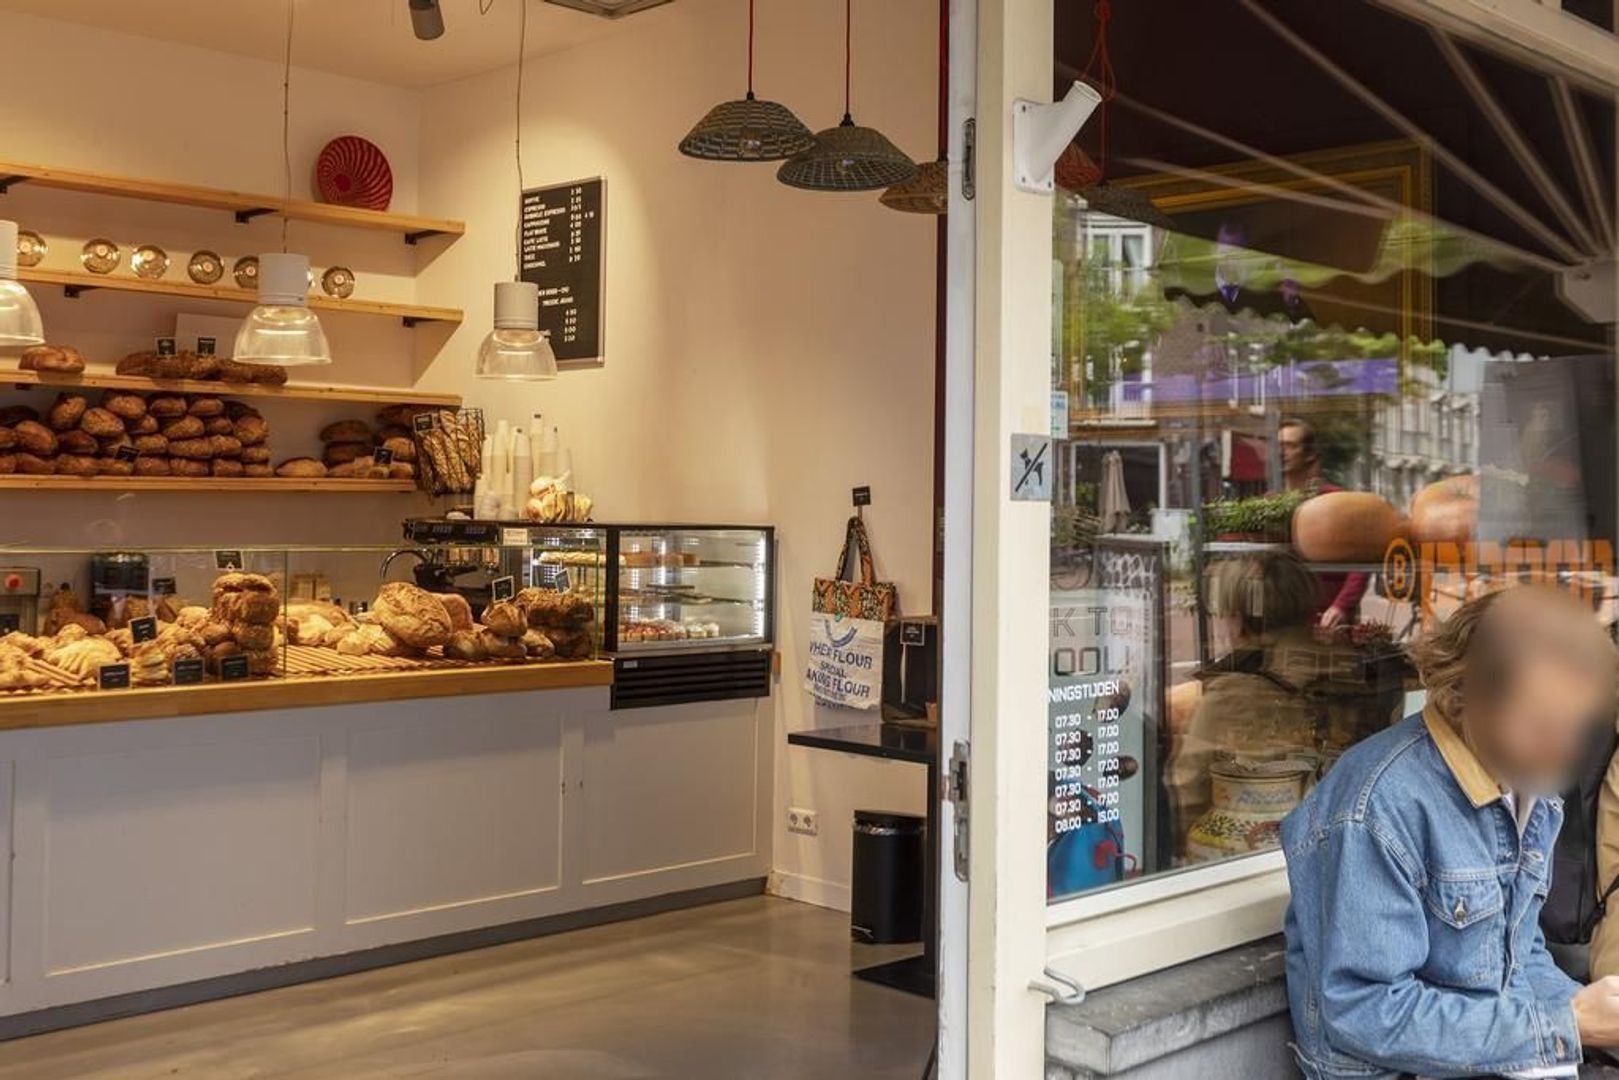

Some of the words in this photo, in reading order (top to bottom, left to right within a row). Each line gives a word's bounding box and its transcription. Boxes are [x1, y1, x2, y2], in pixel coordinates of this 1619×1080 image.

[834, 649, 872, 670] FLOUR
[1050, 645, 1129, 676] OOL!
[833, 678, 870, 699] FLOUR
[1055, 713, 1080, 728] 07.30
[1055, 731, 1080, 746] 07.30
[1055, 748, 1080, 763] 07.30
[1055, 765, 1080, 781] 07.30
[1055, 783, 1080, 798] 07.30
[1055, 799, 1080, 816] 07.30
